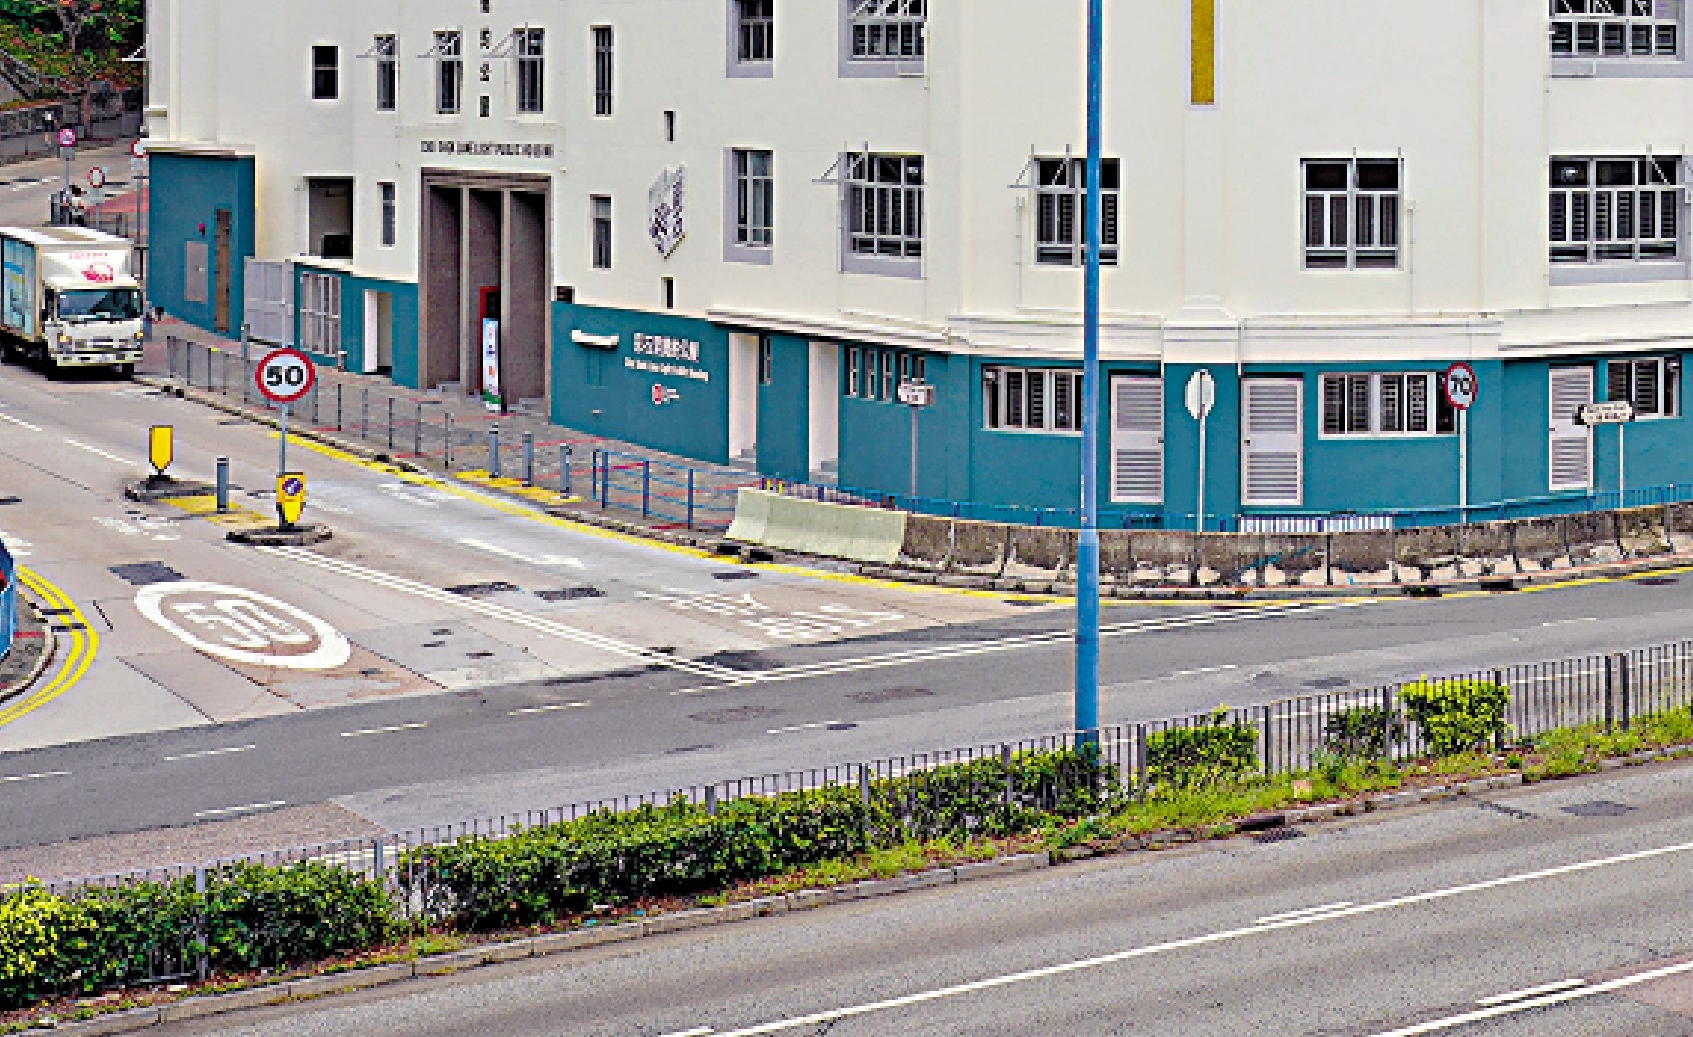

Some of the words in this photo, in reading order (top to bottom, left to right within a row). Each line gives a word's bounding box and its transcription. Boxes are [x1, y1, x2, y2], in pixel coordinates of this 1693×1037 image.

[266, 365, 303, 386] 50
[1450, 375, 1472, 395] 70
[170, 599, 310, 648] 50
